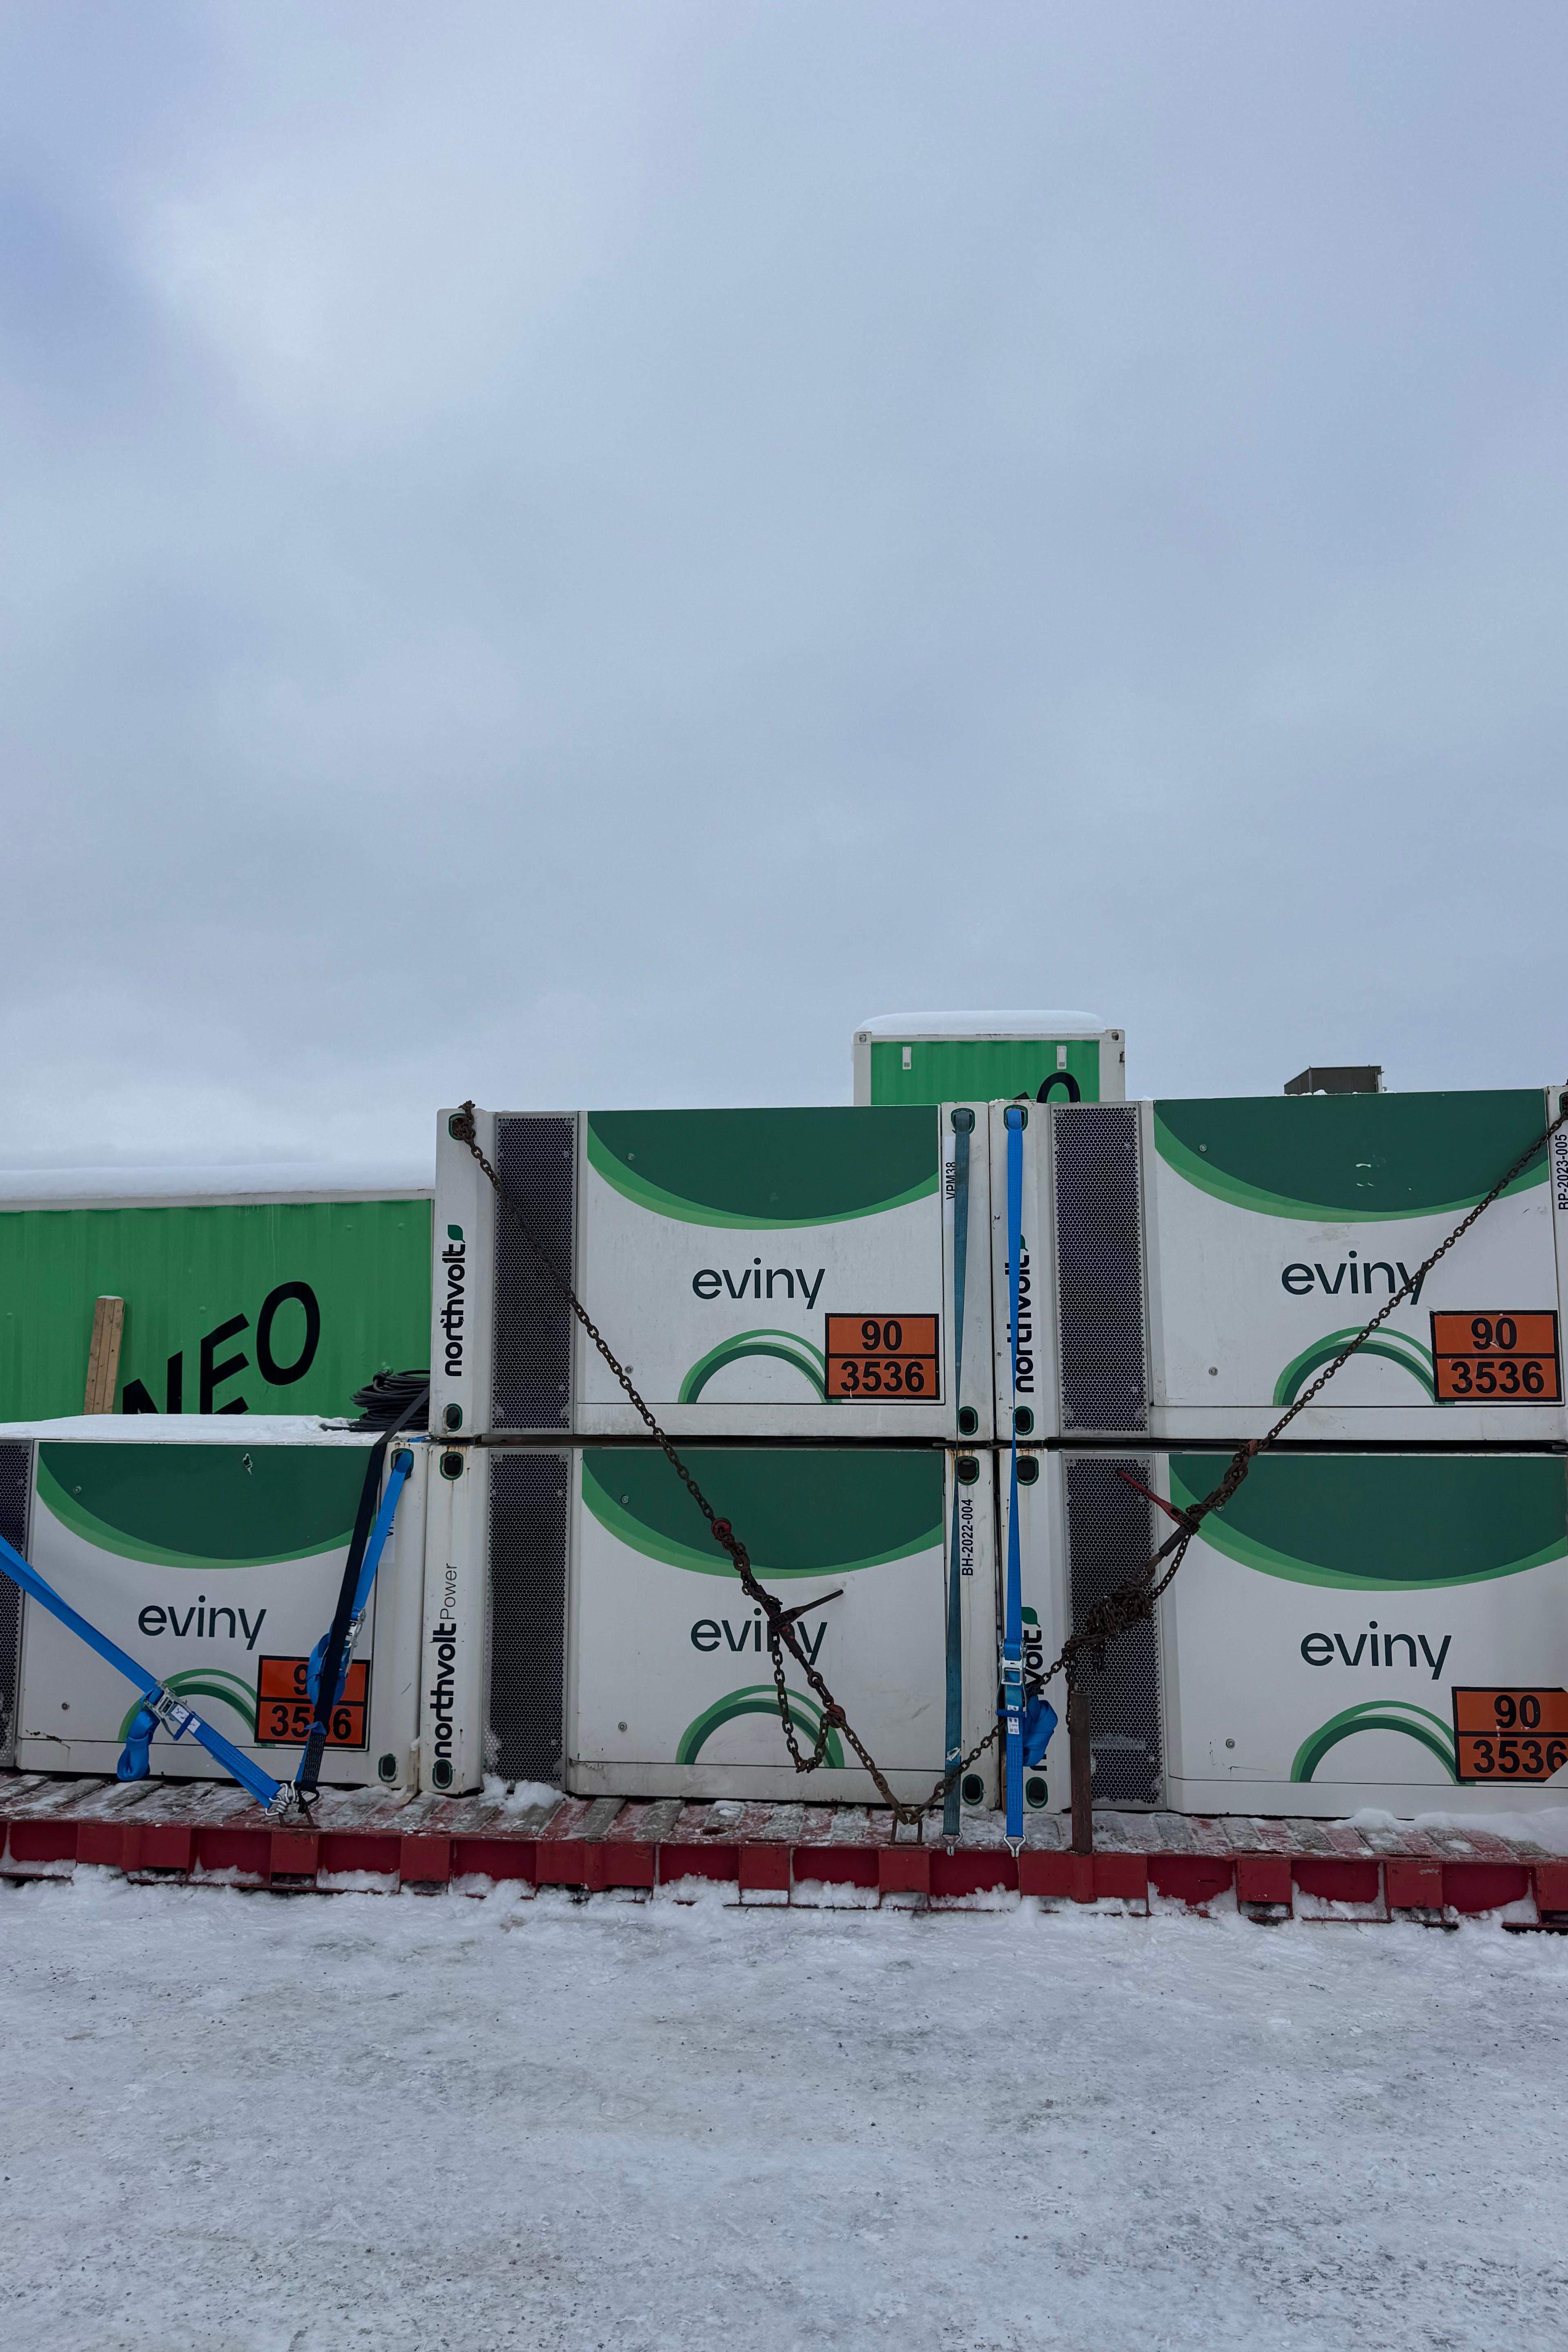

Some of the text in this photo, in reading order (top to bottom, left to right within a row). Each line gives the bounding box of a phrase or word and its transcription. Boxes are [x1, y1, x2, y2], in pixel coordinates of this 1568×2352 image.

[1555, 1134, 1568, 1210] BP-2023-005
[693, 1258, 825, 1309] eviny
[1282, 1251, 1426, 1305] eviny
[440, 1244, 466, 1376] northvolt
[861, 1320, 902, 1351] 90
[1471, 1317, 1517, 1350] 90
[840, 1361, 924, 1392] 3536
[1451, 1361, 1544, 1394] 3536
[961, 1499, 973, 1576] BH-2022-004
[138, 1595, 266, 1650] eviny
[430, 1563, 457, 1758] northvolt Power
[1301, 1621, 1452, 1679] eviny
[270, 1705, 352, 1740] 356
[1494, 1695, 1541, 1729] 90
[1473, 1740, 1568, 1774] 3536
